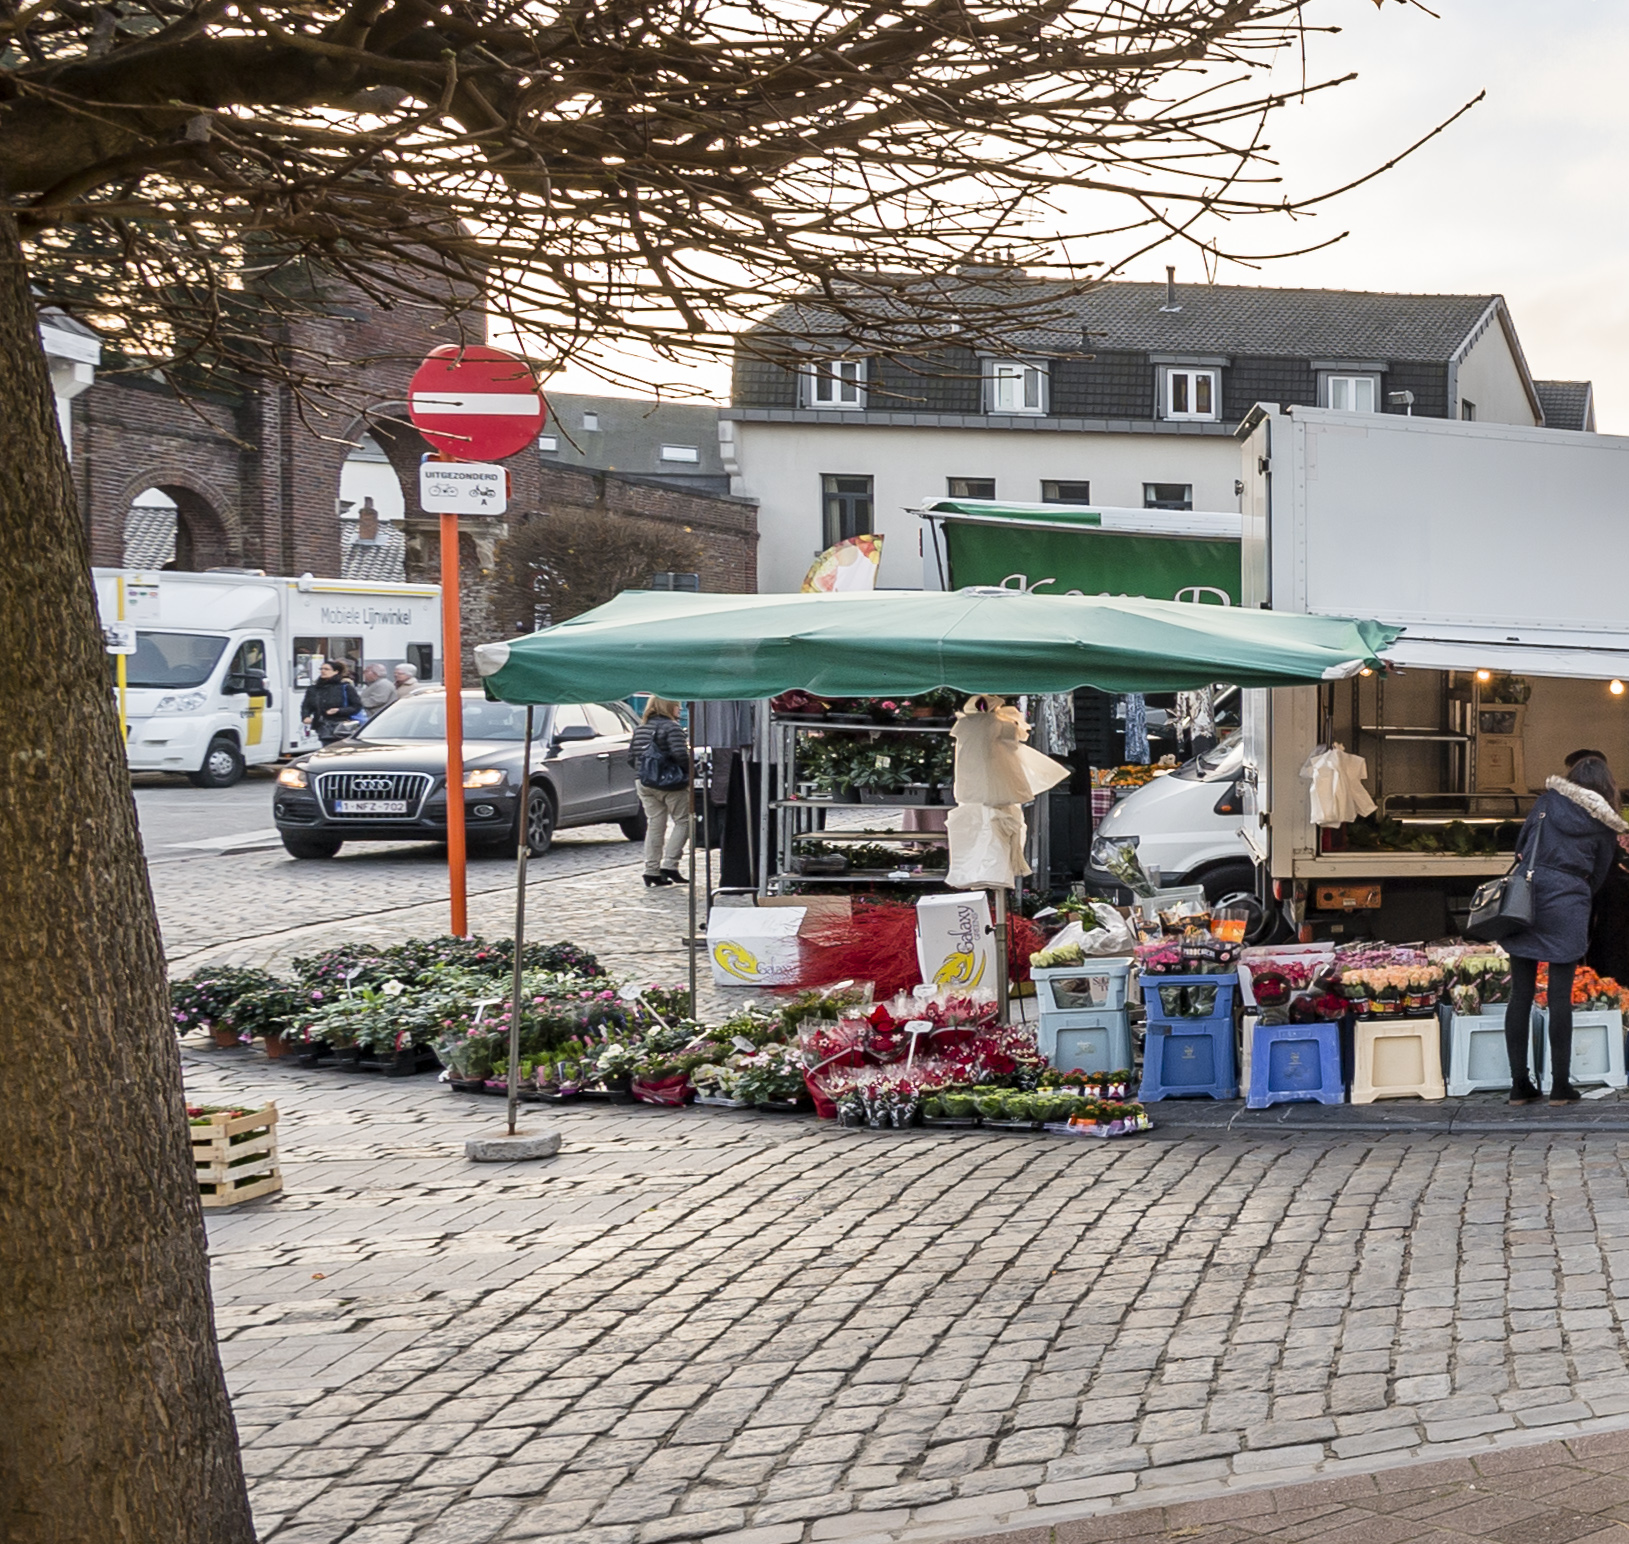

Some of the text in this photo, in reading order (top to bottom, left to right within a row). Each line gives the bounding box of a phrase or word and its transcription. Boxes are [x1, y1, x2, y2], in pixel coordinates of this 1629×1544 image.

[425, 471, 498, 480] UITGEZONDERD
[321, 606, 412, 630] Mobiele Lijnwinkel
[344, 802, 404, 811] 1-NFZ-702
[947, 905, 974, 954] Galaxy
